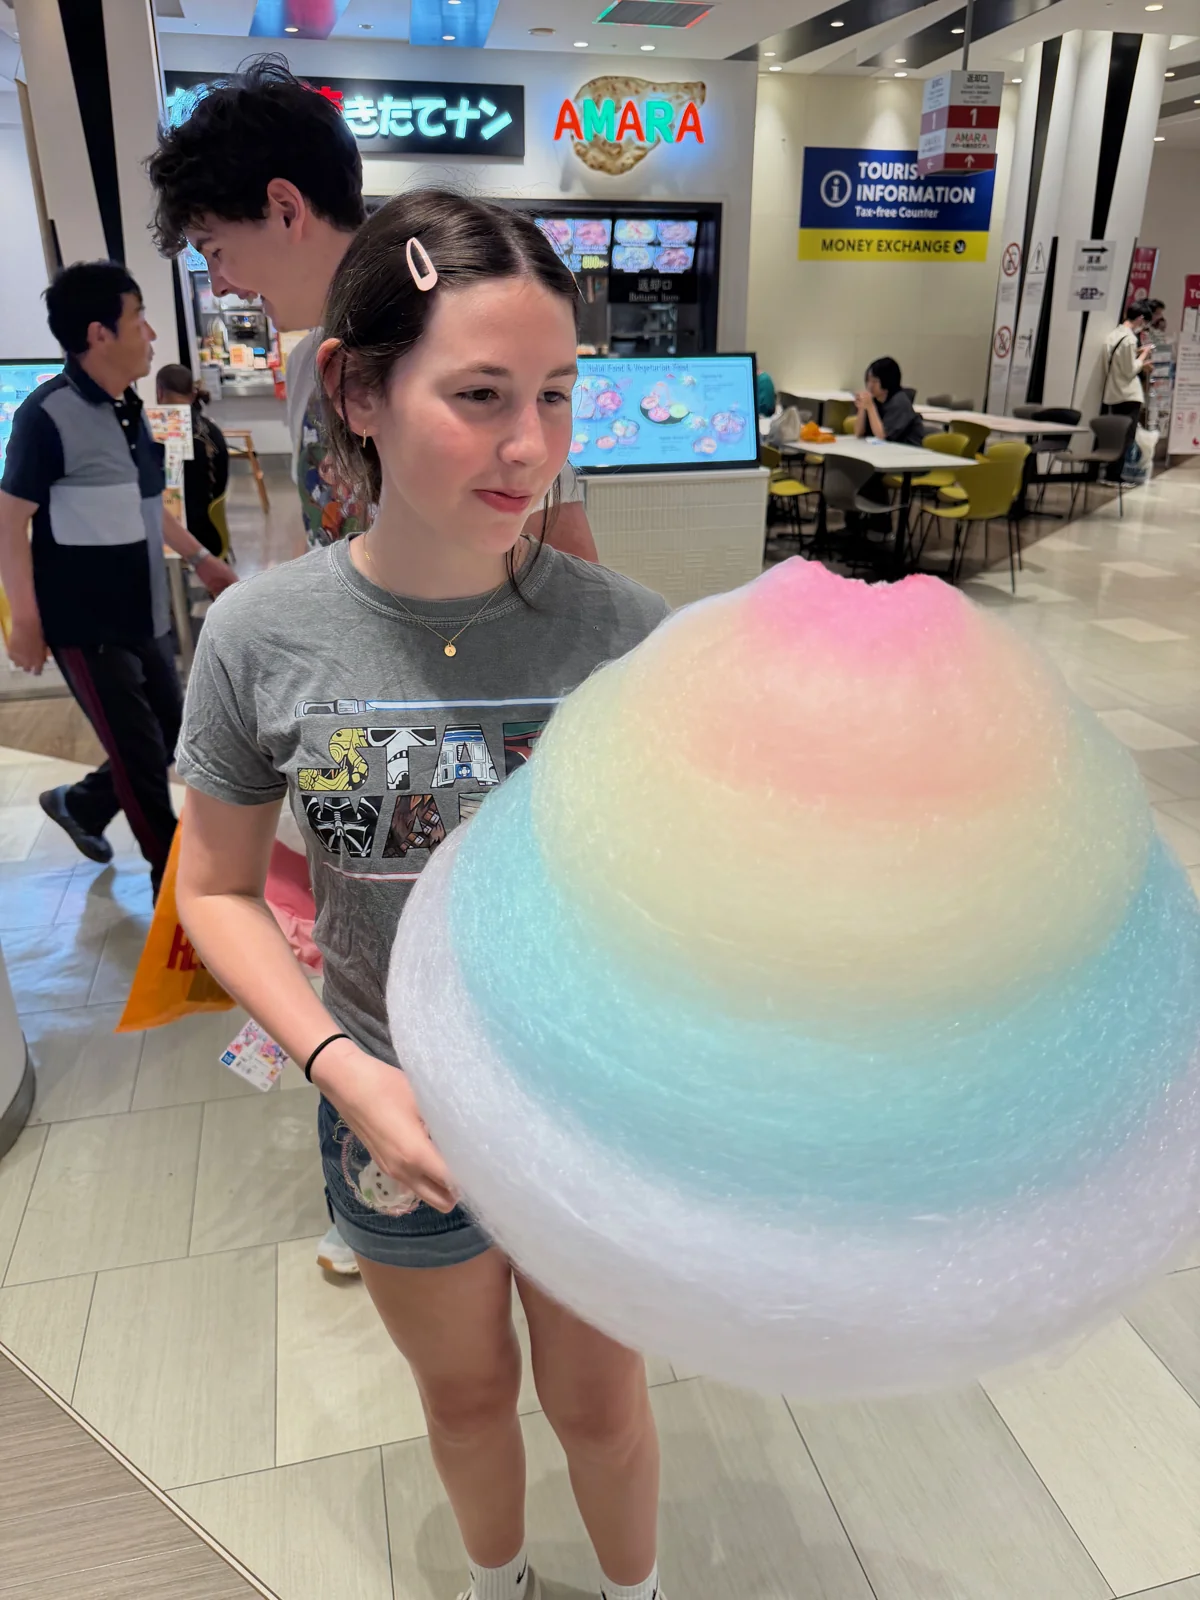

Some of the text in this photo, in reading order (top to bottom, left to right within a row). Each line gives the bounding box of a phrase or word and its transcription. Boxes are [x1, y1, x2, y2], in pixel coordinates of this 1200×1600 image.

[319, 86, 513, 141] きたてナン
[554, 98, 705, 144] AMARA
[970, 108, 978, 127] 1
[954, 132, 988, 143] AMARA
[858, 161, 925, 181] TOURIS
[856, 184, 976, 204] INFORMATION
[855, 205, 939, 219] Tax-free Counter
[821, 238, 950, 254] MONEY EXCHANGE
